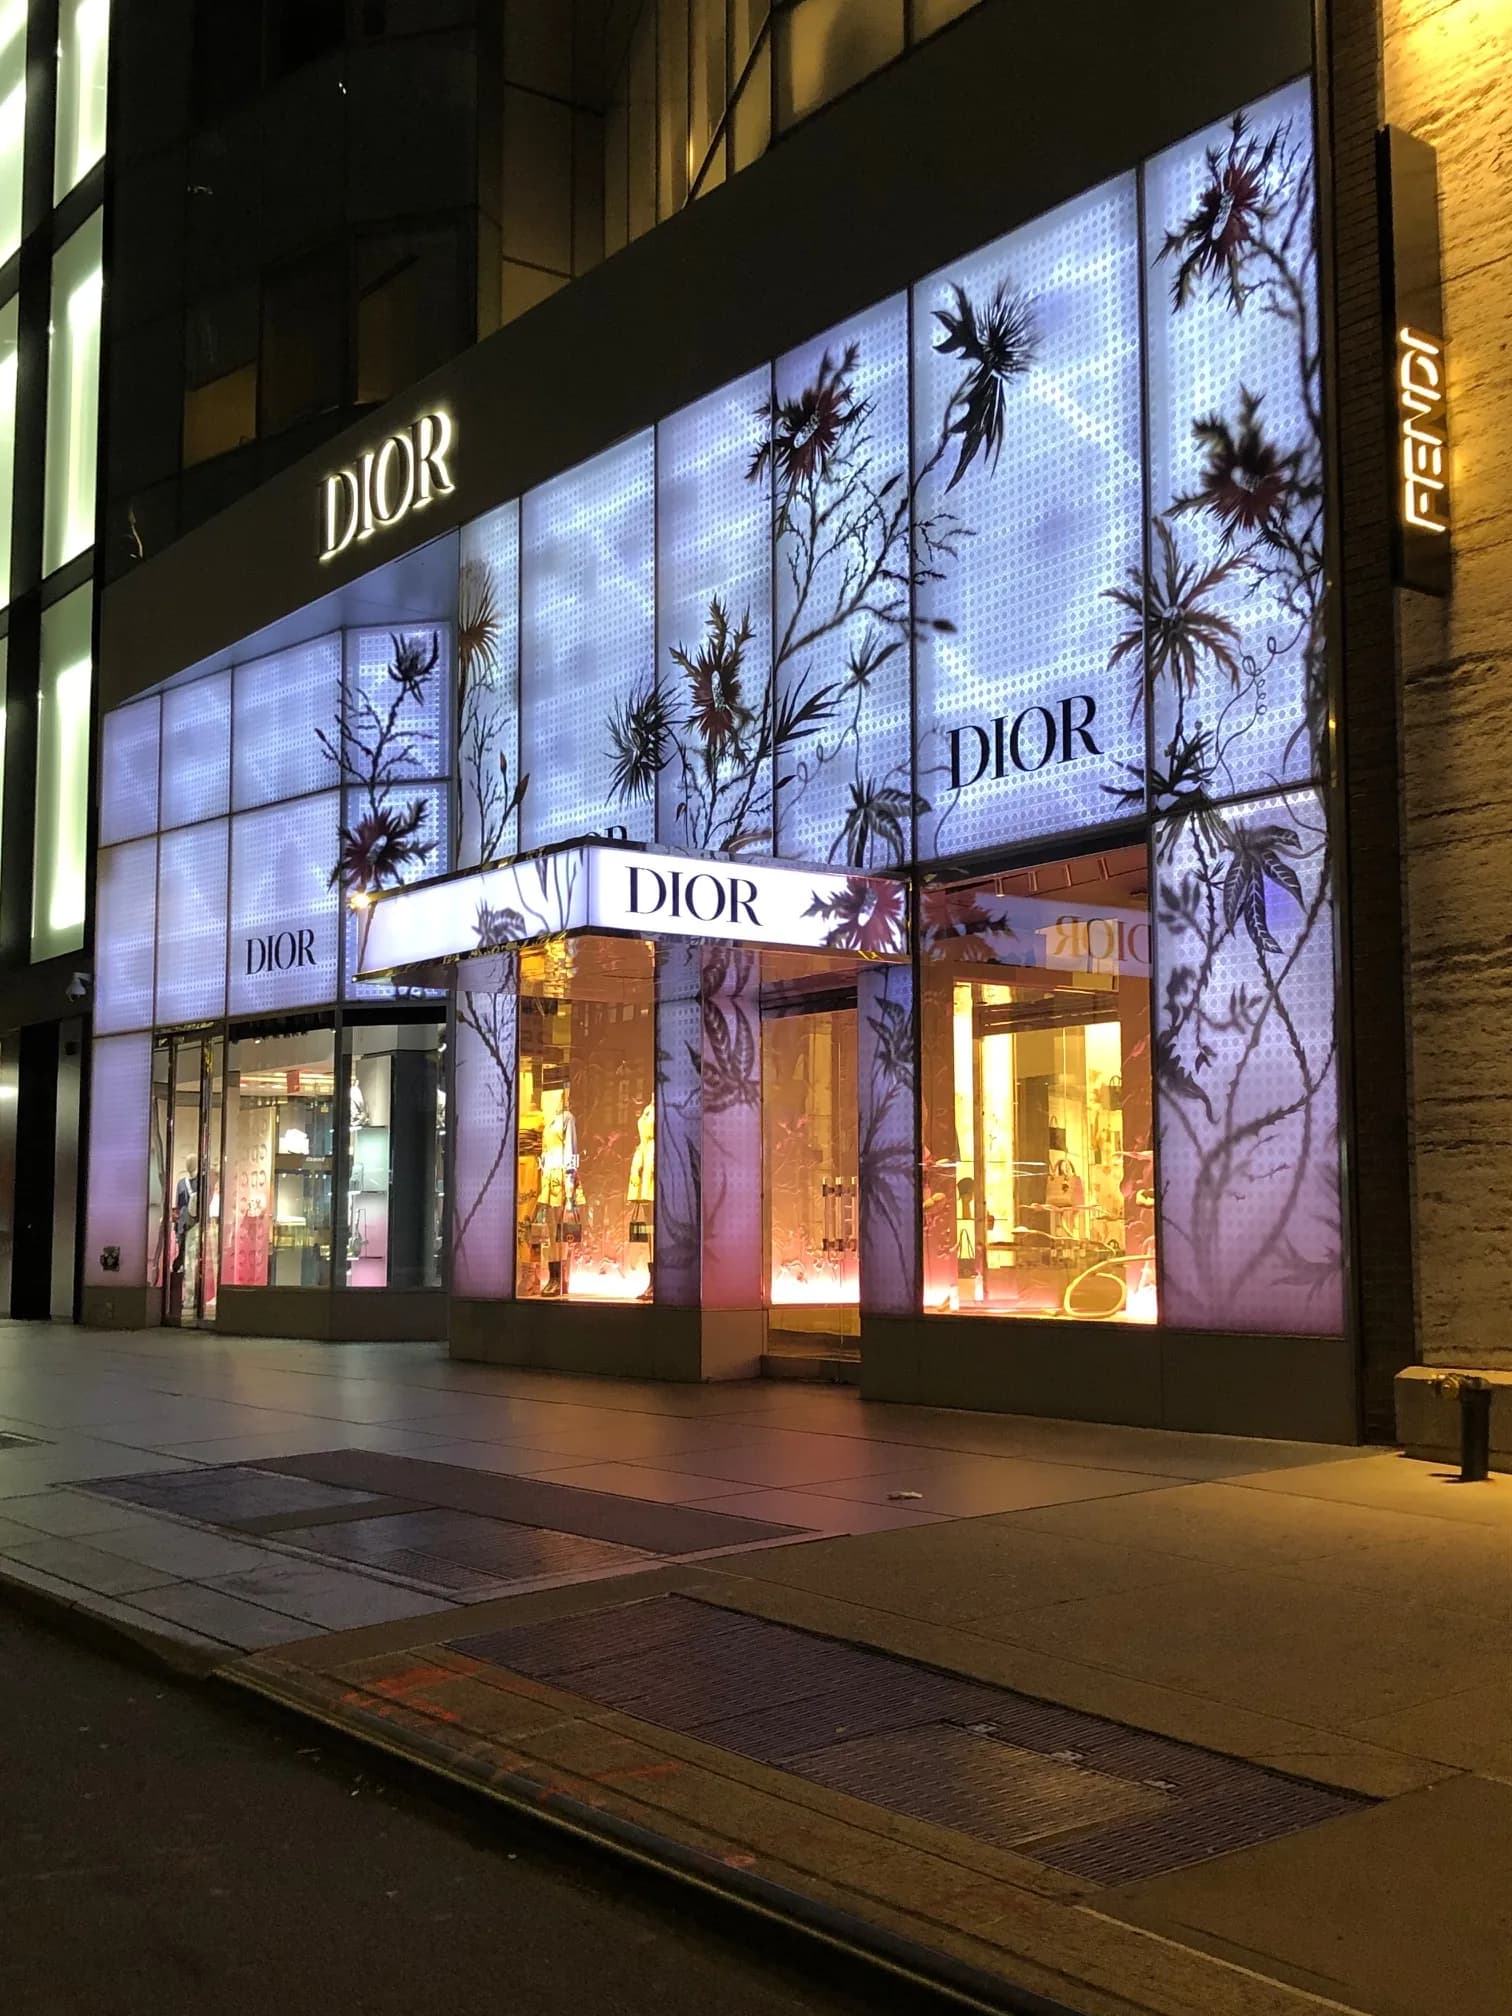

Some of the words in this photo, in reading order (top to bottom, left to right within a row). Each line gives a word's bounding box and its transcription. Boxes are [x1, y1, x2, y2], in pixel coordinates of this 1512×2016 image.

[1400, 327, 1446, 532] FENDI
[316, 411, 456, 562] DIOR
[946, 695, 1104, 791] DIOR
[625, 866, 764, 926] DIOR
[245, 928, 317, 976] DIOR
